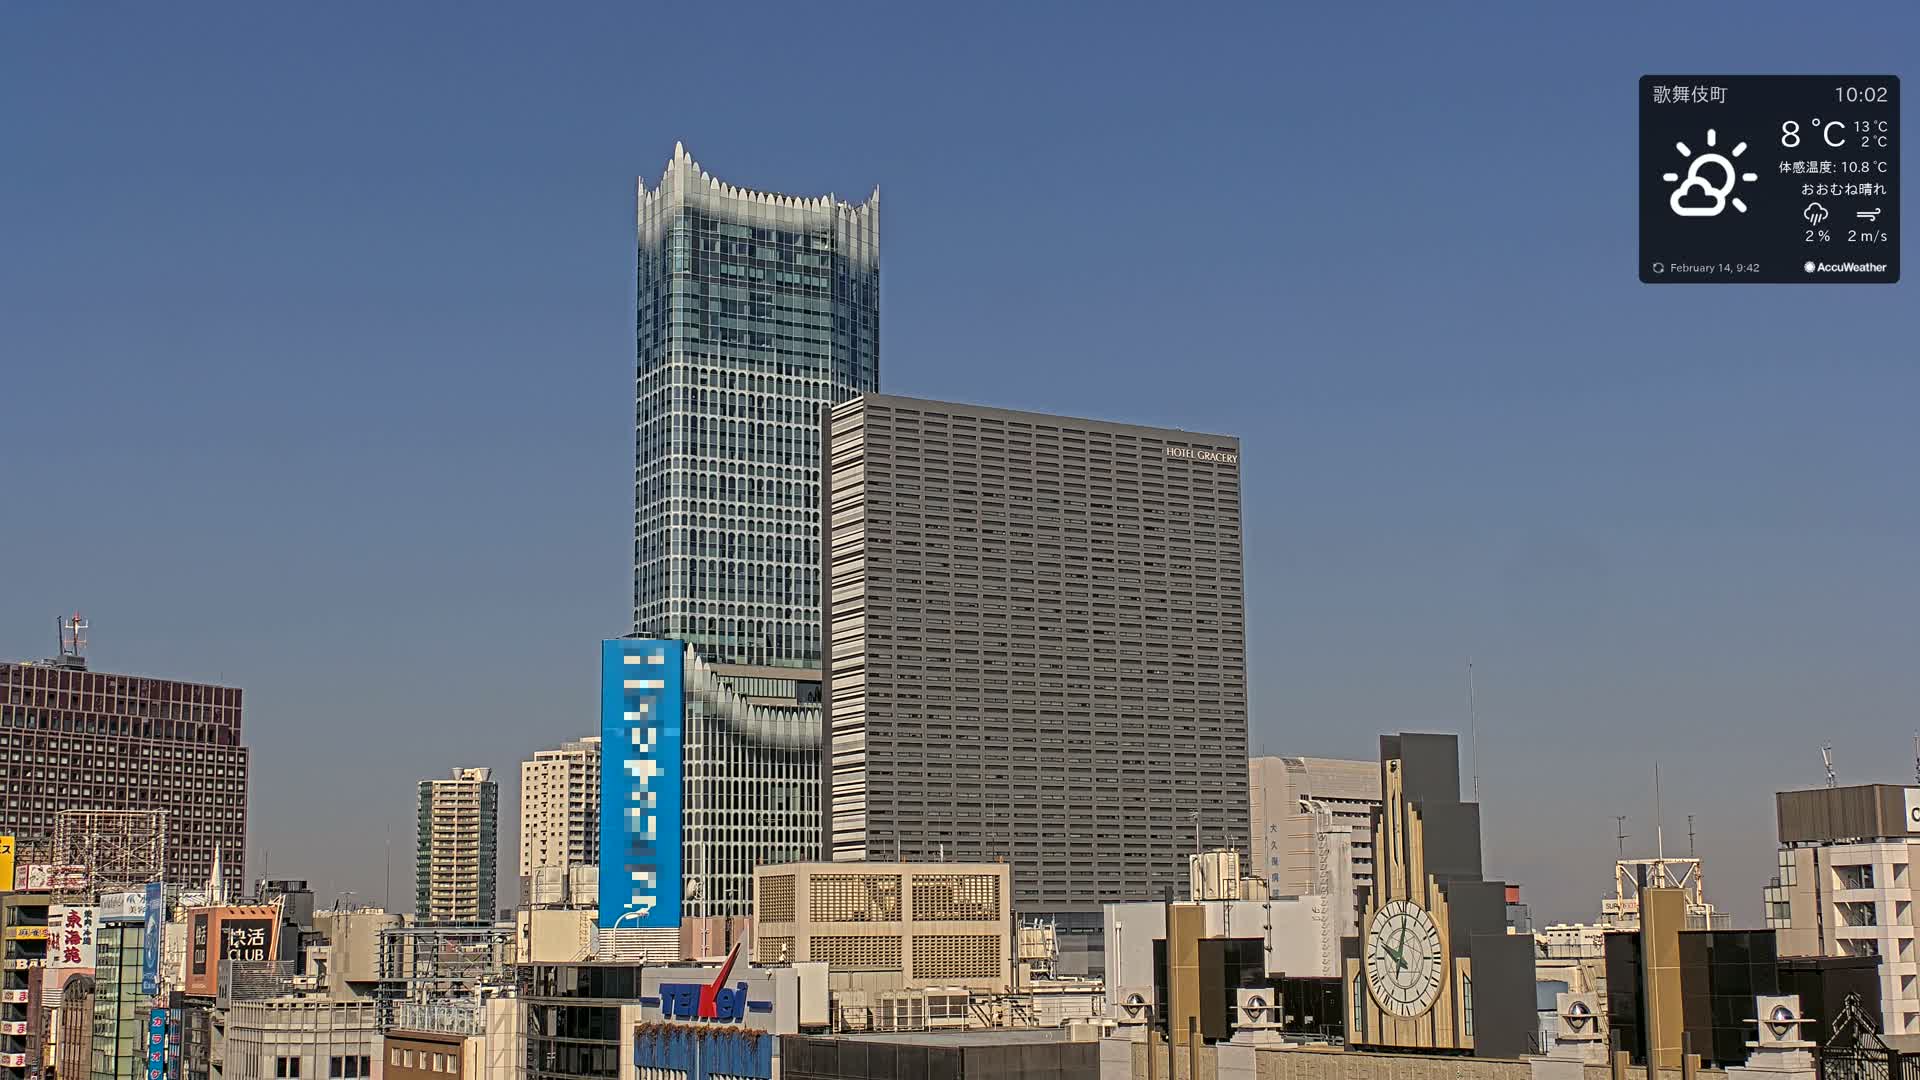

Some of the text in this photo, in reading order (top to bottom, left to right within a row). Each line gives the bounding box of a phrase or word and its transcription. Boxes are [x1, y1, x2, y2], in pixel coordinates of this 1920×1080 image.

[1166, 447, 1238, 464] HOTEL GRACERY
[63, 909, 82, 964] 東海苑
[230, 927, 265, 947] 快活
[150, 1016, 163, 1080] カラオケ
